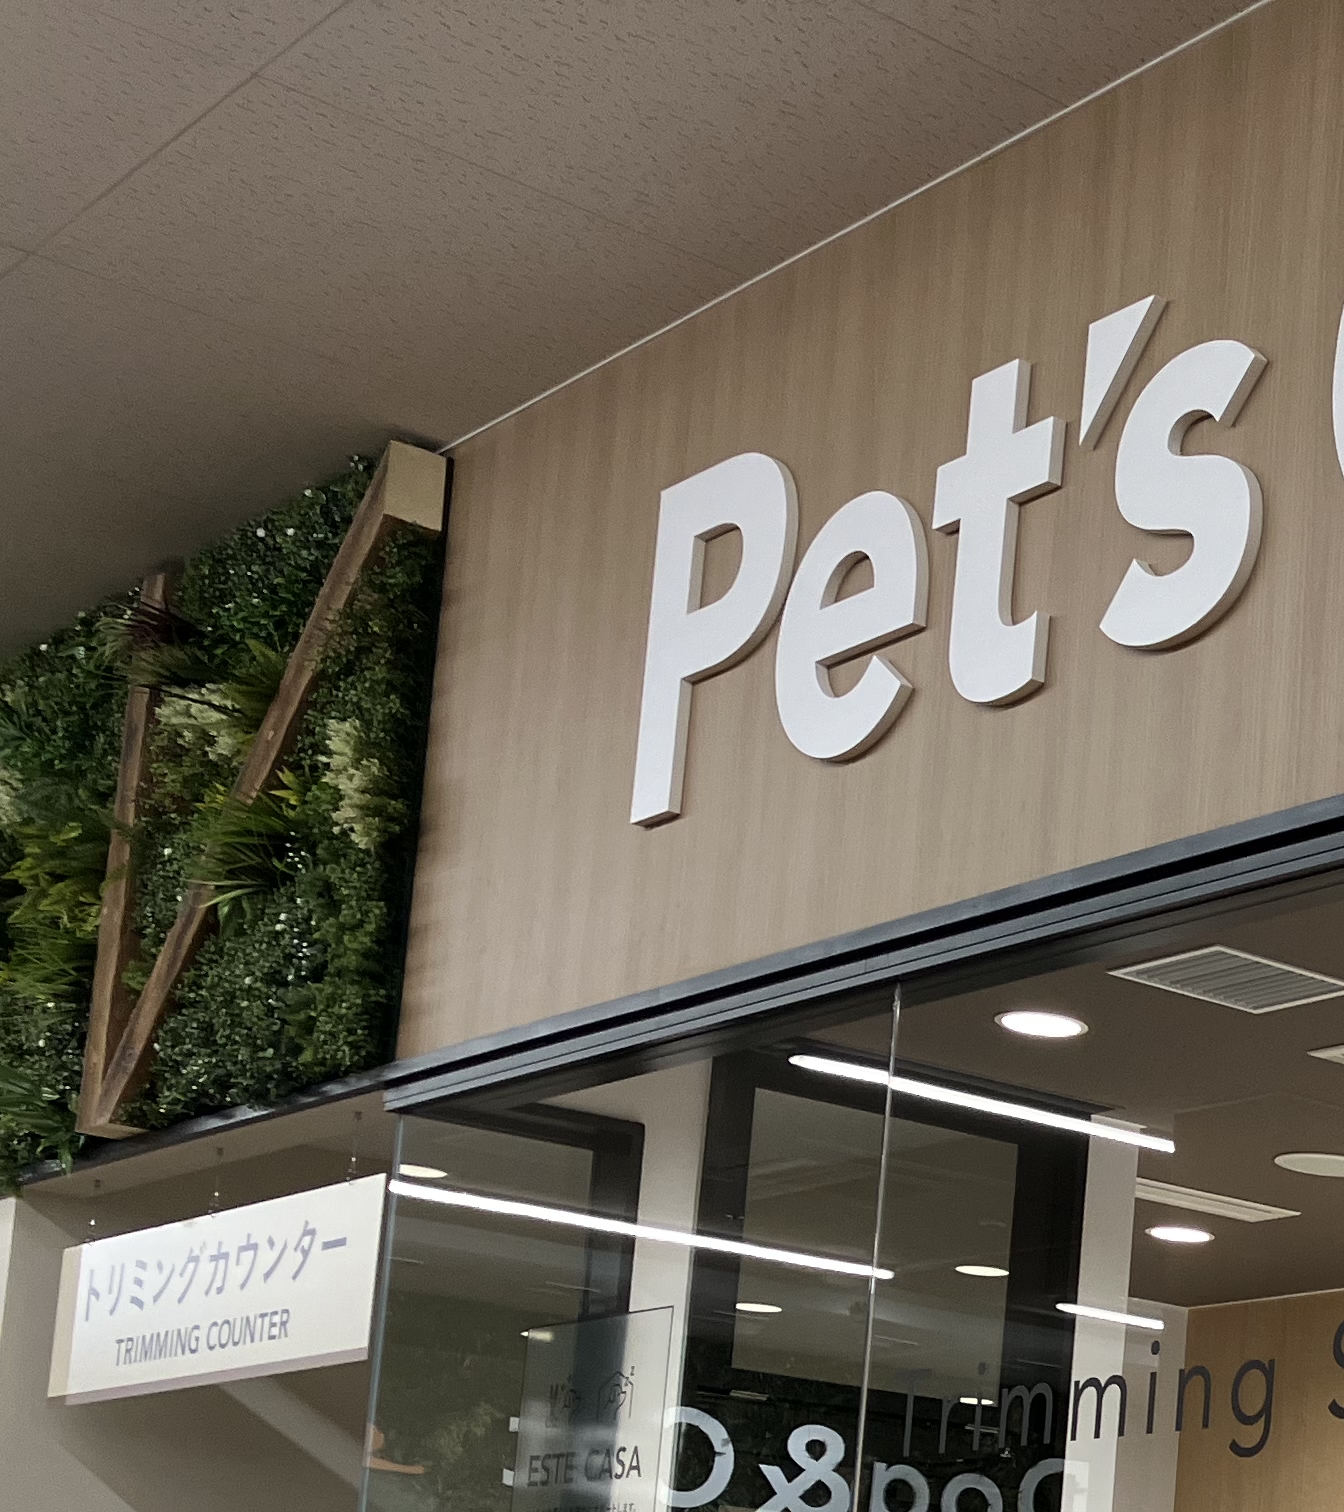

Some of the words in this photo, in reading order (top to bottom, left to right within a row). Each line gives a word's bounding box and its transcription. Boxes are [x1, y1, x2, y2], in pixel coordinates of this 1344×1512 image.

[631, 294, 1268, 828] Pet's
[84, 1220, 347, 1322] トリミングカウンター
[115, 1325, 200, 1366] TRIMMING
[206, 1308, 290, 1351] COUNTER
[895, 1340, 1275, 1458] Trimming
[527, 1452, 577, 1488] ESTE
[585, 1446, 642, 1481] CASA
